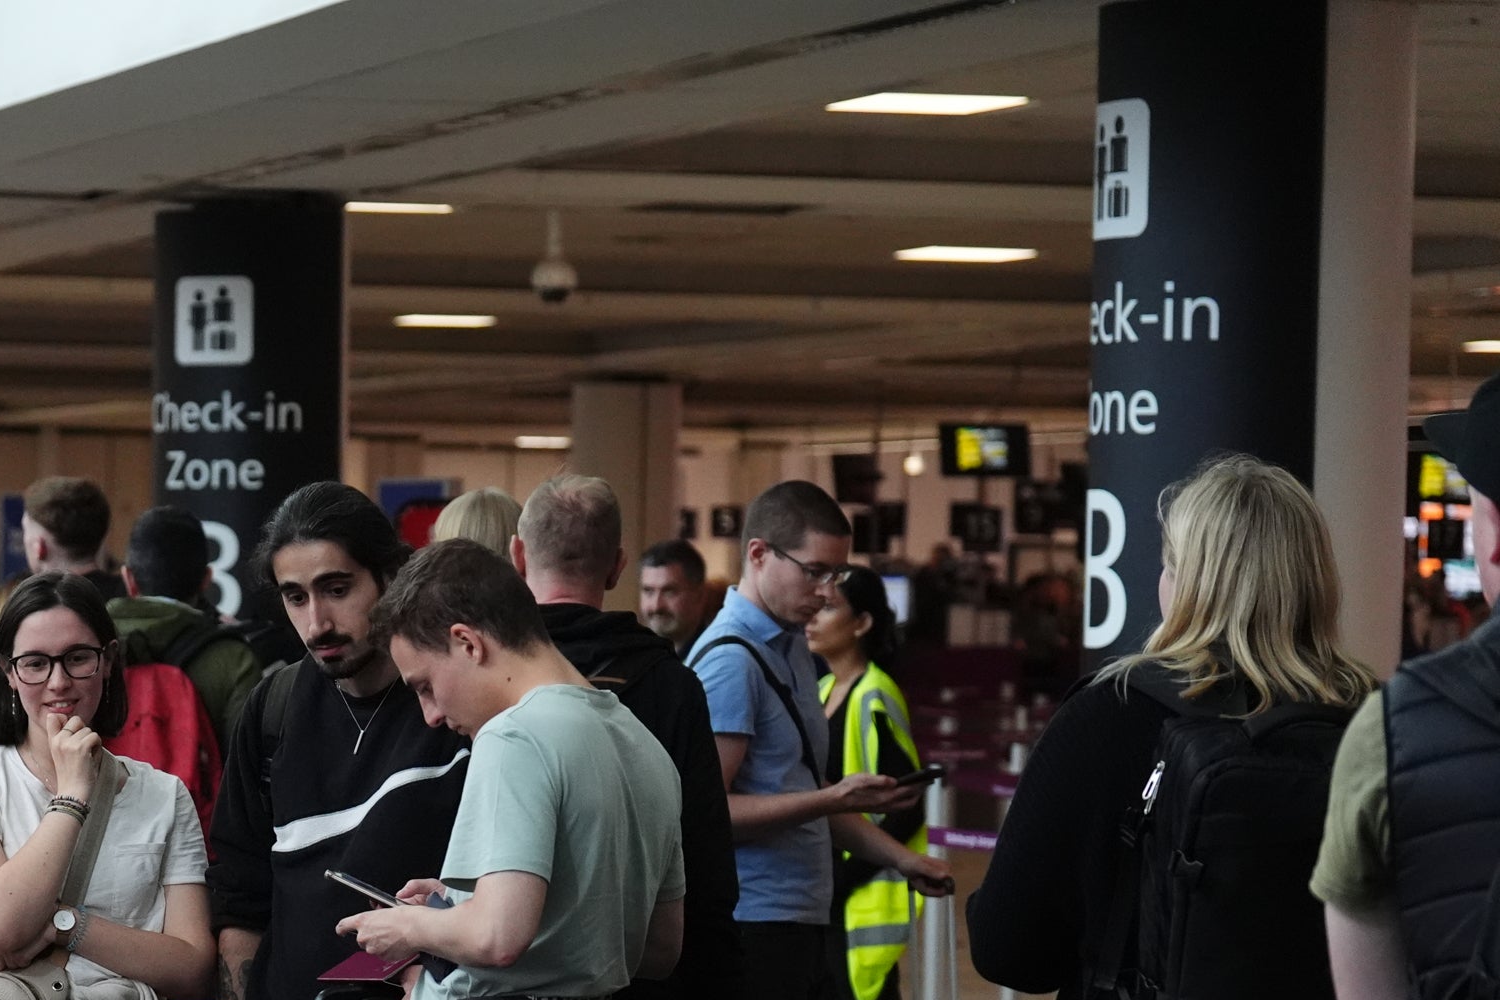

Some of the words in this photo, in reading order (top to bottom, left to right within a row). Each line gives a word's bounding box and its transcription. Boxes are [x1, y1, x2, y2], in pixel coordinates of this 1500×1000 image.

[1089, 280, 1221, 344] eck-in
[152, 389, 304, 434] Check-in
[1088, 387, 1160, 436] one
[164, 450, 266, 492] Zone
[1083, 488, 1128, 651] B
